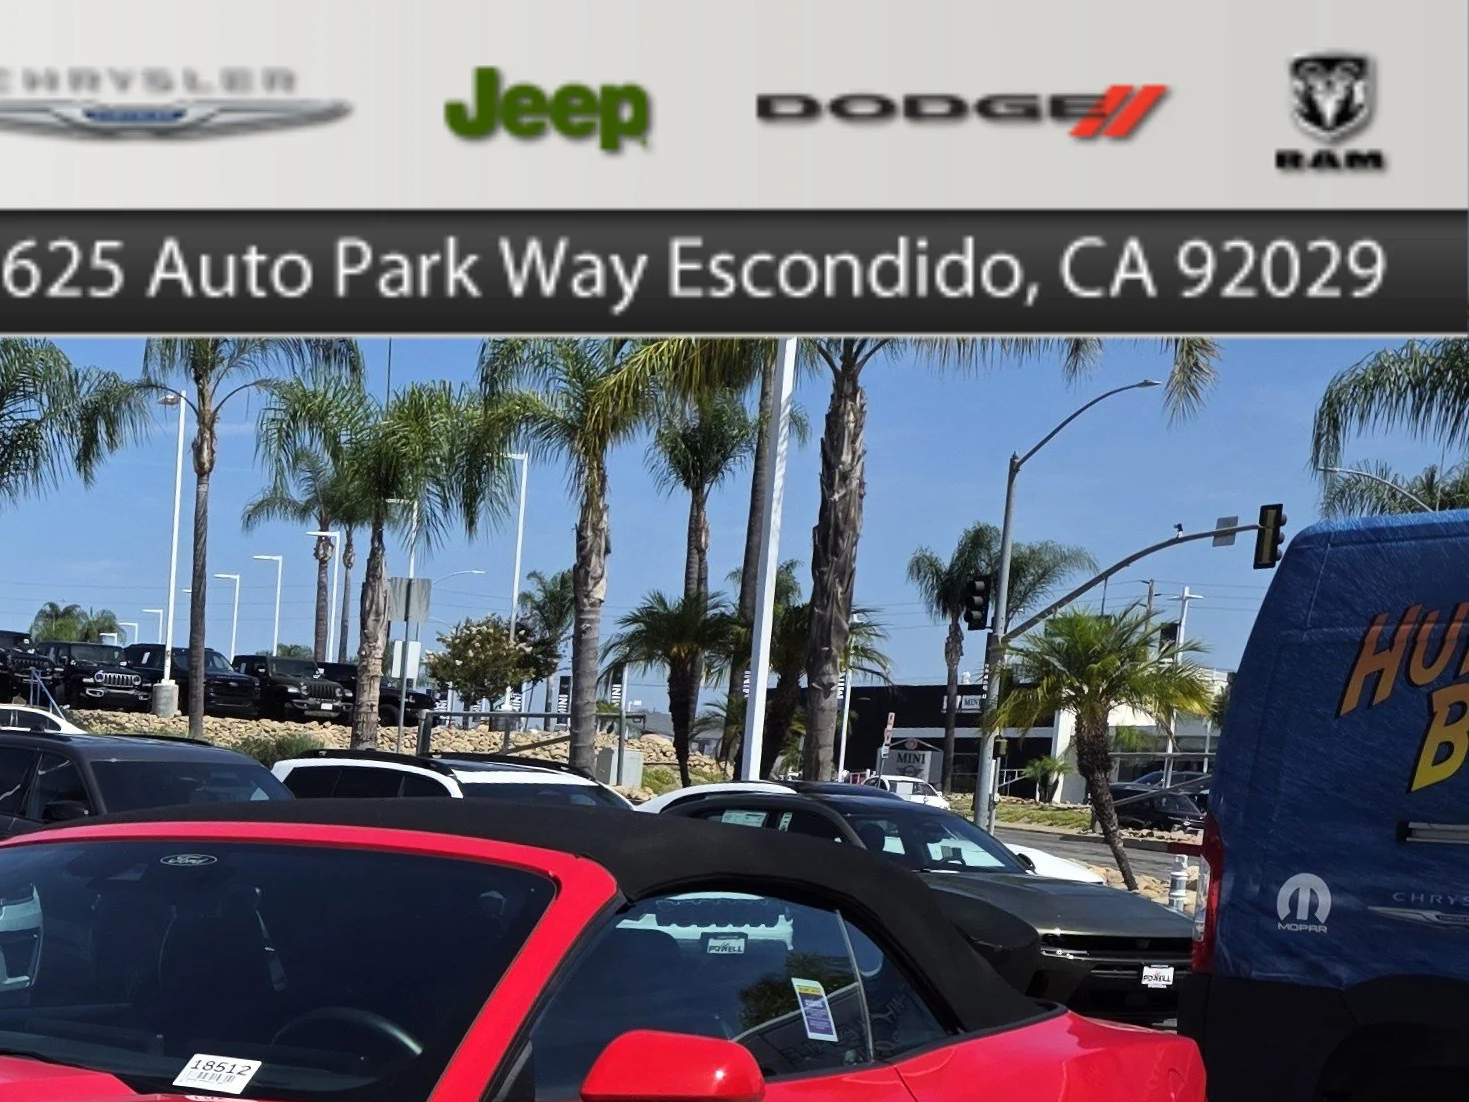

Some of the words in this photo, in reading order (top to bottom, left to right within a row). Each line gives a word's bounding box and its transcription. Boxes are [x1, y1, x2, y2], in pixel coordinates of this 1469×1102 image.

[1335, 603, 1469, 720] HU
[897, 751, 927, 765] MINI
[1277, 922, 1328, 933] MOPAR
[190, 1059, 252, 1077] 18512
